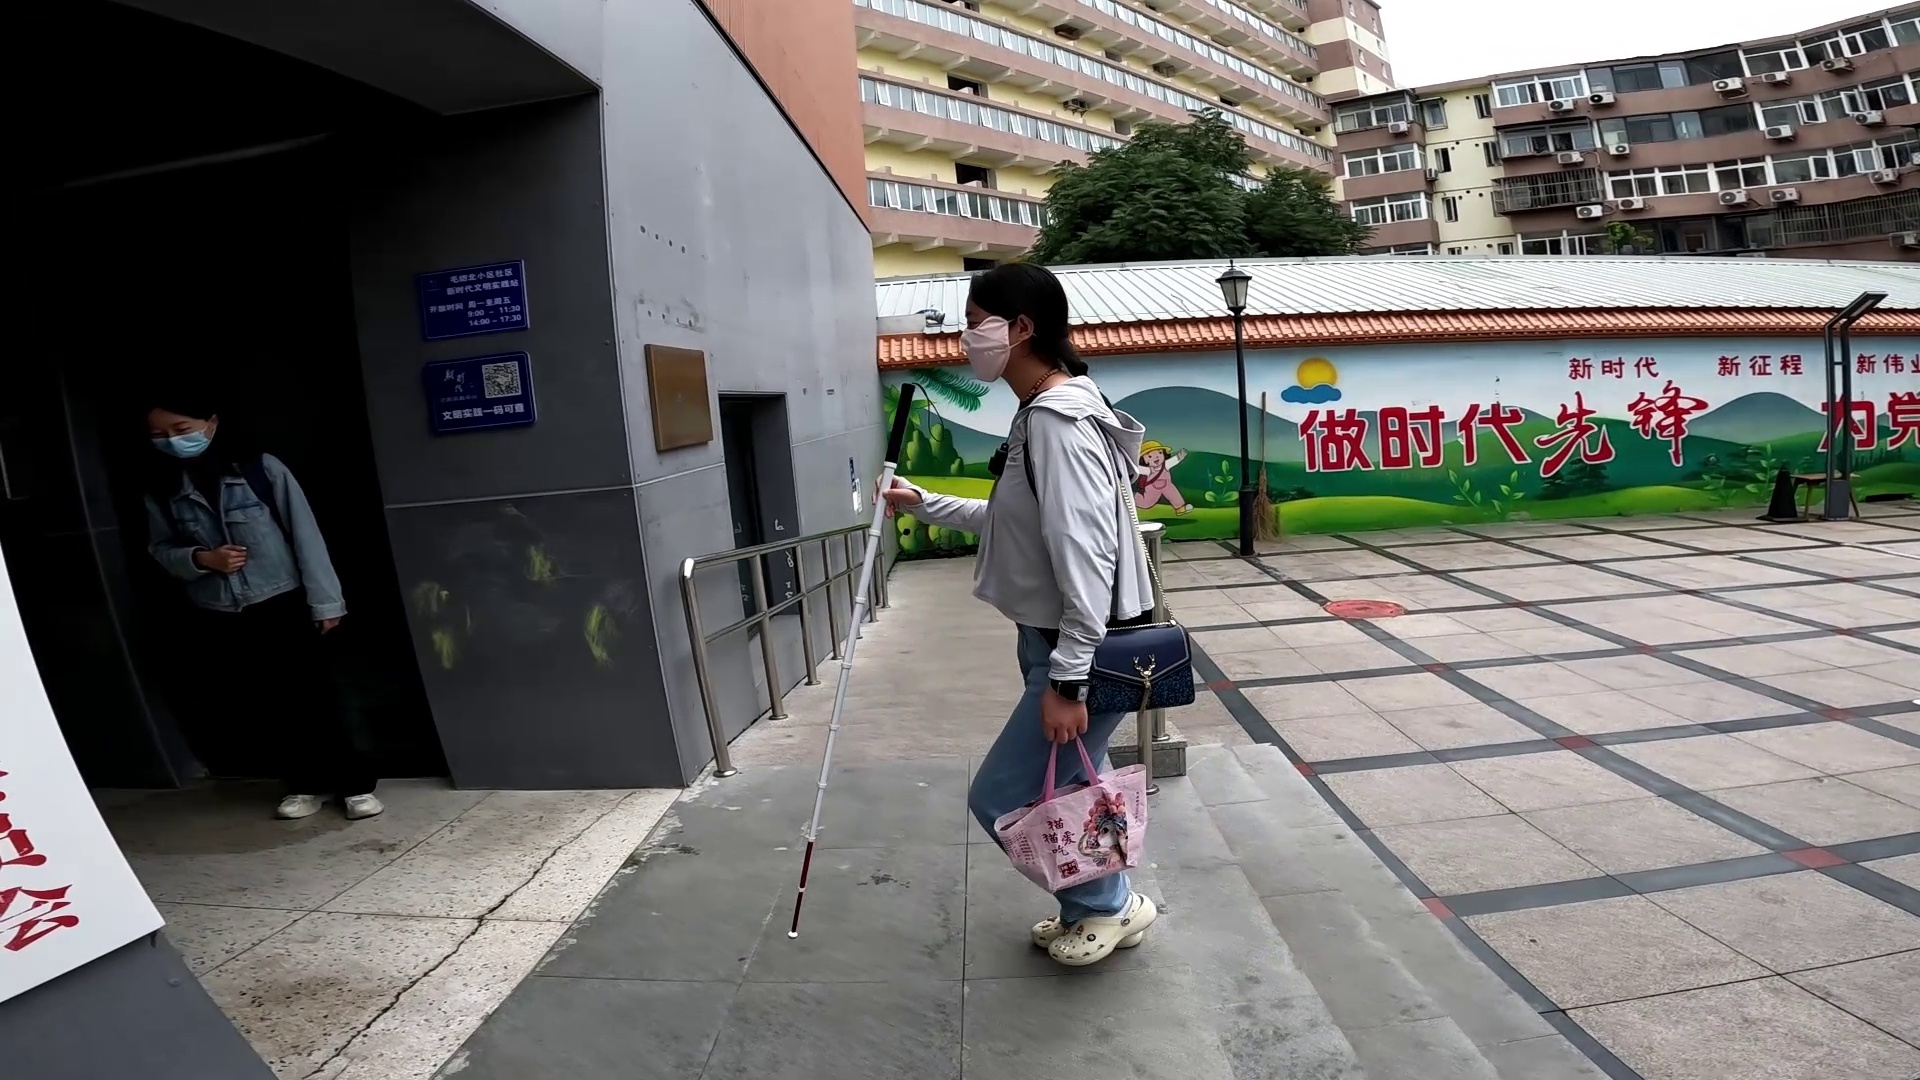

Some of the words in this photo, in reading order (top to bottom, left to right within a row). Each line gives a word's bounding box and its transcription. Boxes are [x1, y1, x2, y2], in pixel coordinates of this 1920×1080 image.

[468, 297, 511, 308] 周一至周五
[499, 305, 520, 313] 11:30
[469, 318, 490, 326] 14:00
[500, 314, 521, 322] 17:30
[1568, 356, 1659, 380] 新时代
[1718, 354, 1804, 377] 新征程
[1299, 380, 1709, 477] 做时代先锋
